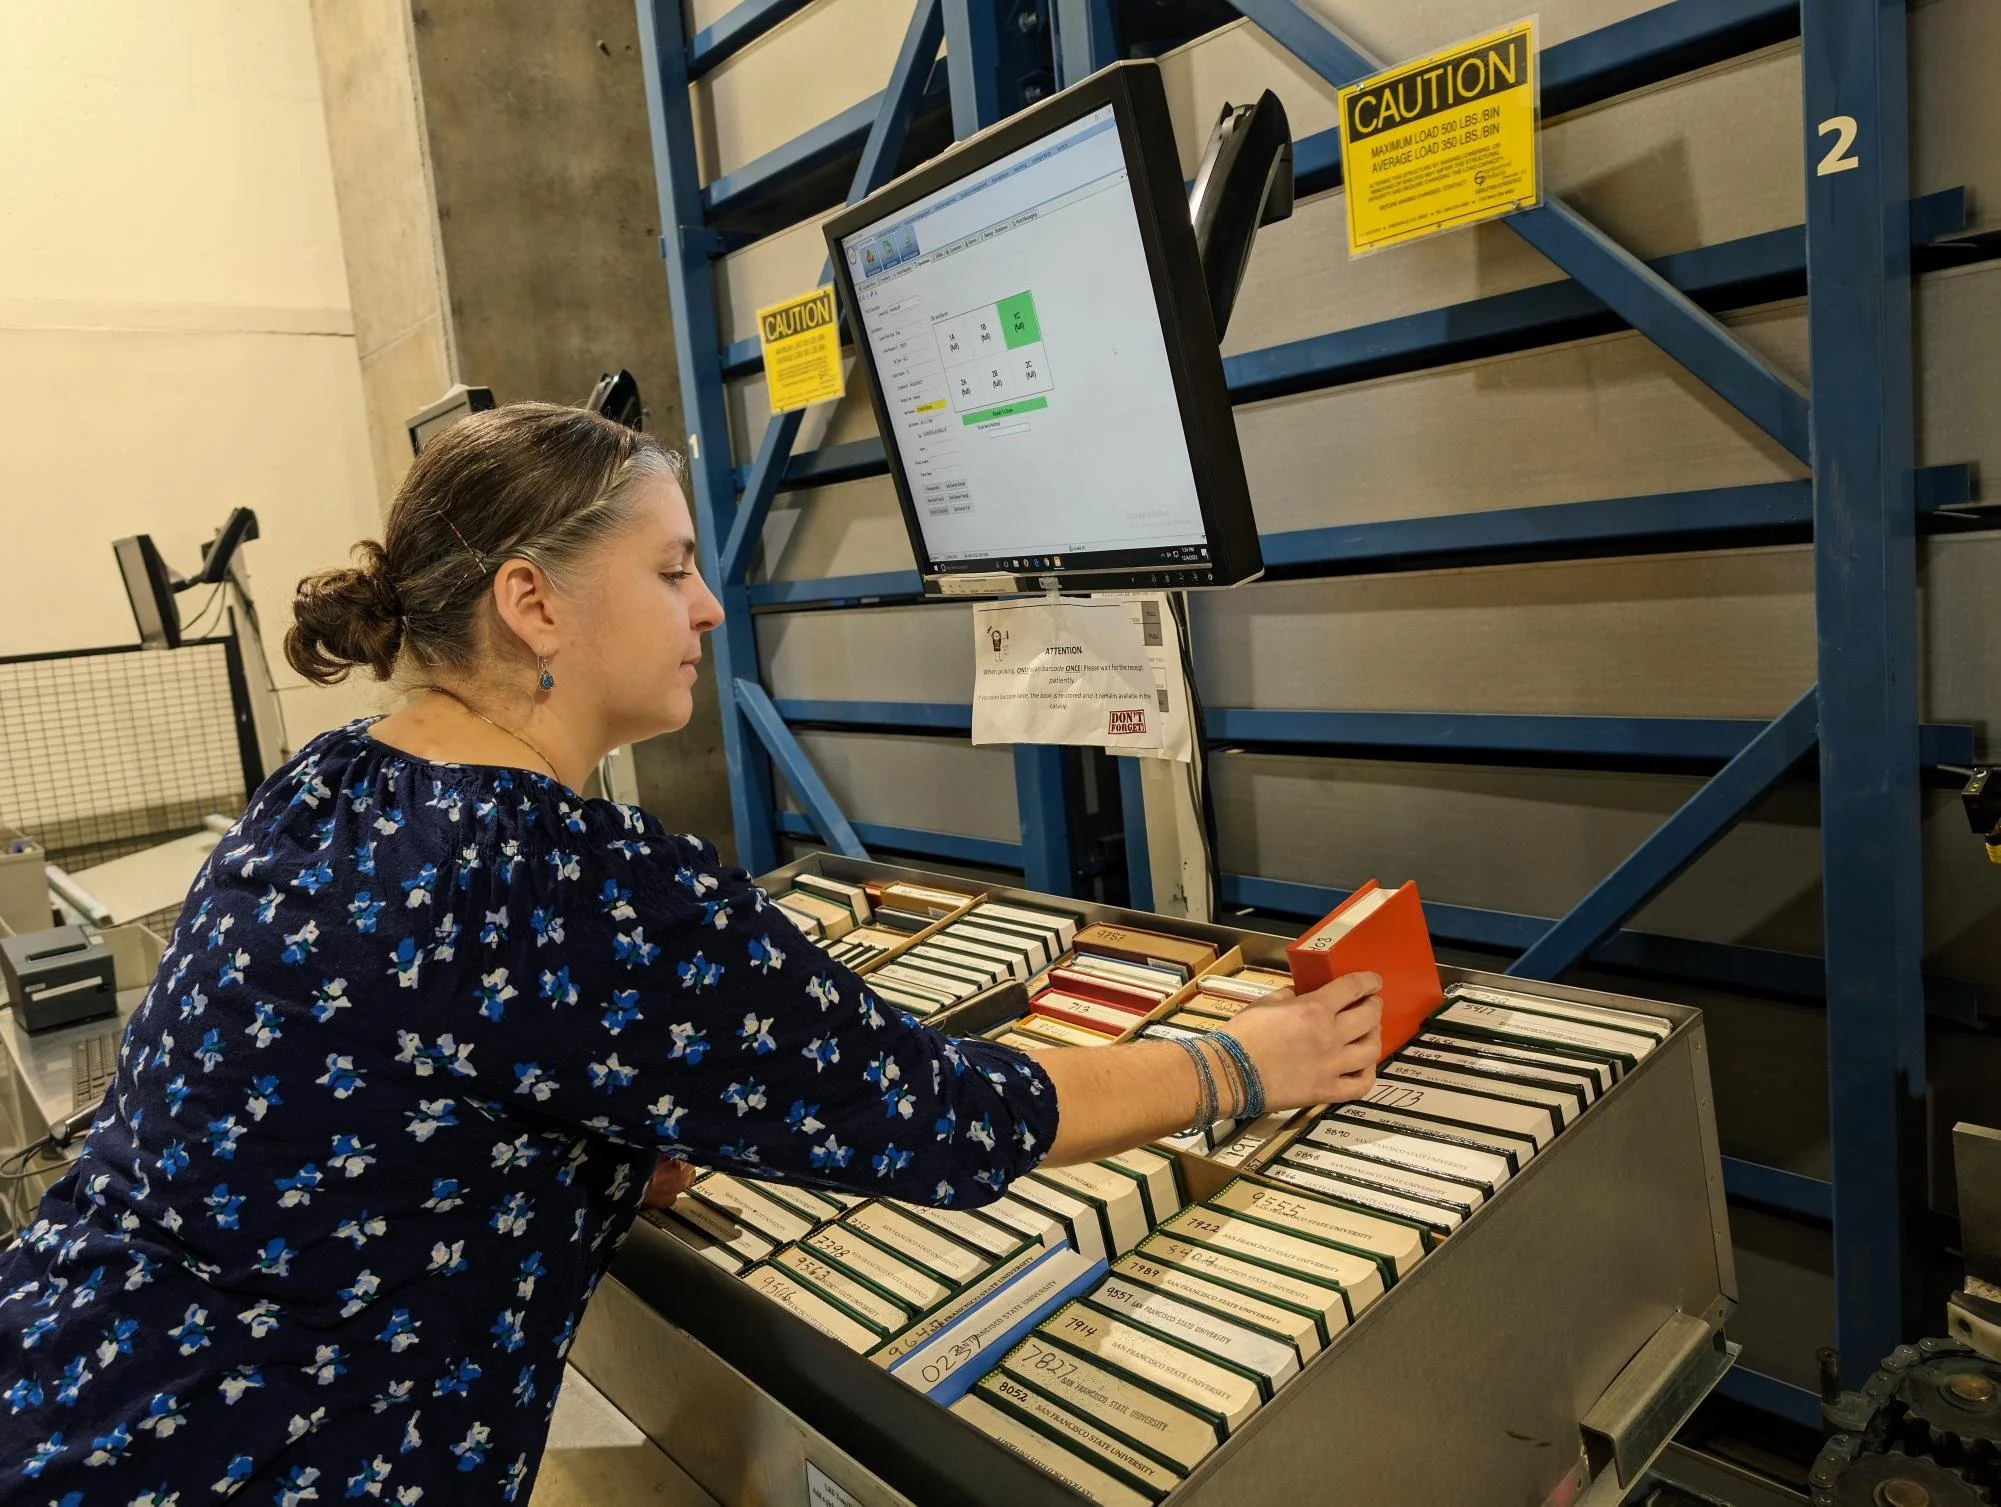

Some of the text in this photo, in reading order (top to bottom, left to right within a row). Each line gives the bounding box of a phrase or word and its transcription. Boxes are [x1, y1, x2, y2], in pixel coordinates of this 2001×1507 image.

[1354, 43, 1516, 133] CAUTION
[1371, 136, 1413, 158] MAXIMUM
[1414, 127, 1439, 145] LOAD
[1441, 119, 1457, 136] 500
[1371, 153, 1413, 174] AVERAGE
[1414, 141, 1439, 159] LOAD
[1441, 135, 1457, 151] 350
[1817, 116, 1859, 176] 2
[766, 297, 830, 340] CAUTION
[689, 433, 700, 459] 1
[1045, 646, 1082, 655] ATTENTION
[1112, 711, 1144, 723] DON'T
[1187, 1216, 1221, 1234] 7922
[1308, 1218, 1330, 1228] STATE
[1329, 1224, 1373, 1240] UNIVERSITY
[1130, 1261, 1160, 1278] 7989
[1223, 1233, 1238, 1241] SAN
[1274, 1249, 1297, 1260] STATE
[1296, 1256, 1339, 1273] UNIVERSITY
[943, 1294, 982, 1323] FRANCISCO
[979, 1280, 1000, 1297] STATE
[997, 1255, 1035, 1283] UNIVERSITY
[1001, 1302, 1024, 1320] STATE
[1021, 1278, 1058, 1305] UNIVERSITY
[1106, 1285, 1133, 1303] 9557
[1166, 1278, 1281, 1325] SAN FRANCISCO STATE UNIVERSITY
[1260, 1279, 1310, 1300] UNIVERSITY
[1064, 1315, 1099, 1339] 7914
[1130, 1300, 1232, 1345] SAN FRANCISCO STATE UNIVERSITY
[920, 1334, 981, 1384] 0237
[1021, 1342, 1079, 1379] 7827
[1111, 1341, 1232, 1400] SAN FRANCISCO STATE UNIVERSITY
[999, 1381, 1028, 1404] 8052
[1059, 1376, 1169, 1432] SAN FRANCISCO STATE UNIVERSITY
[1034, 1404, 1156, 1476] SAN FRANCISCO STATE UNIVERSITY
